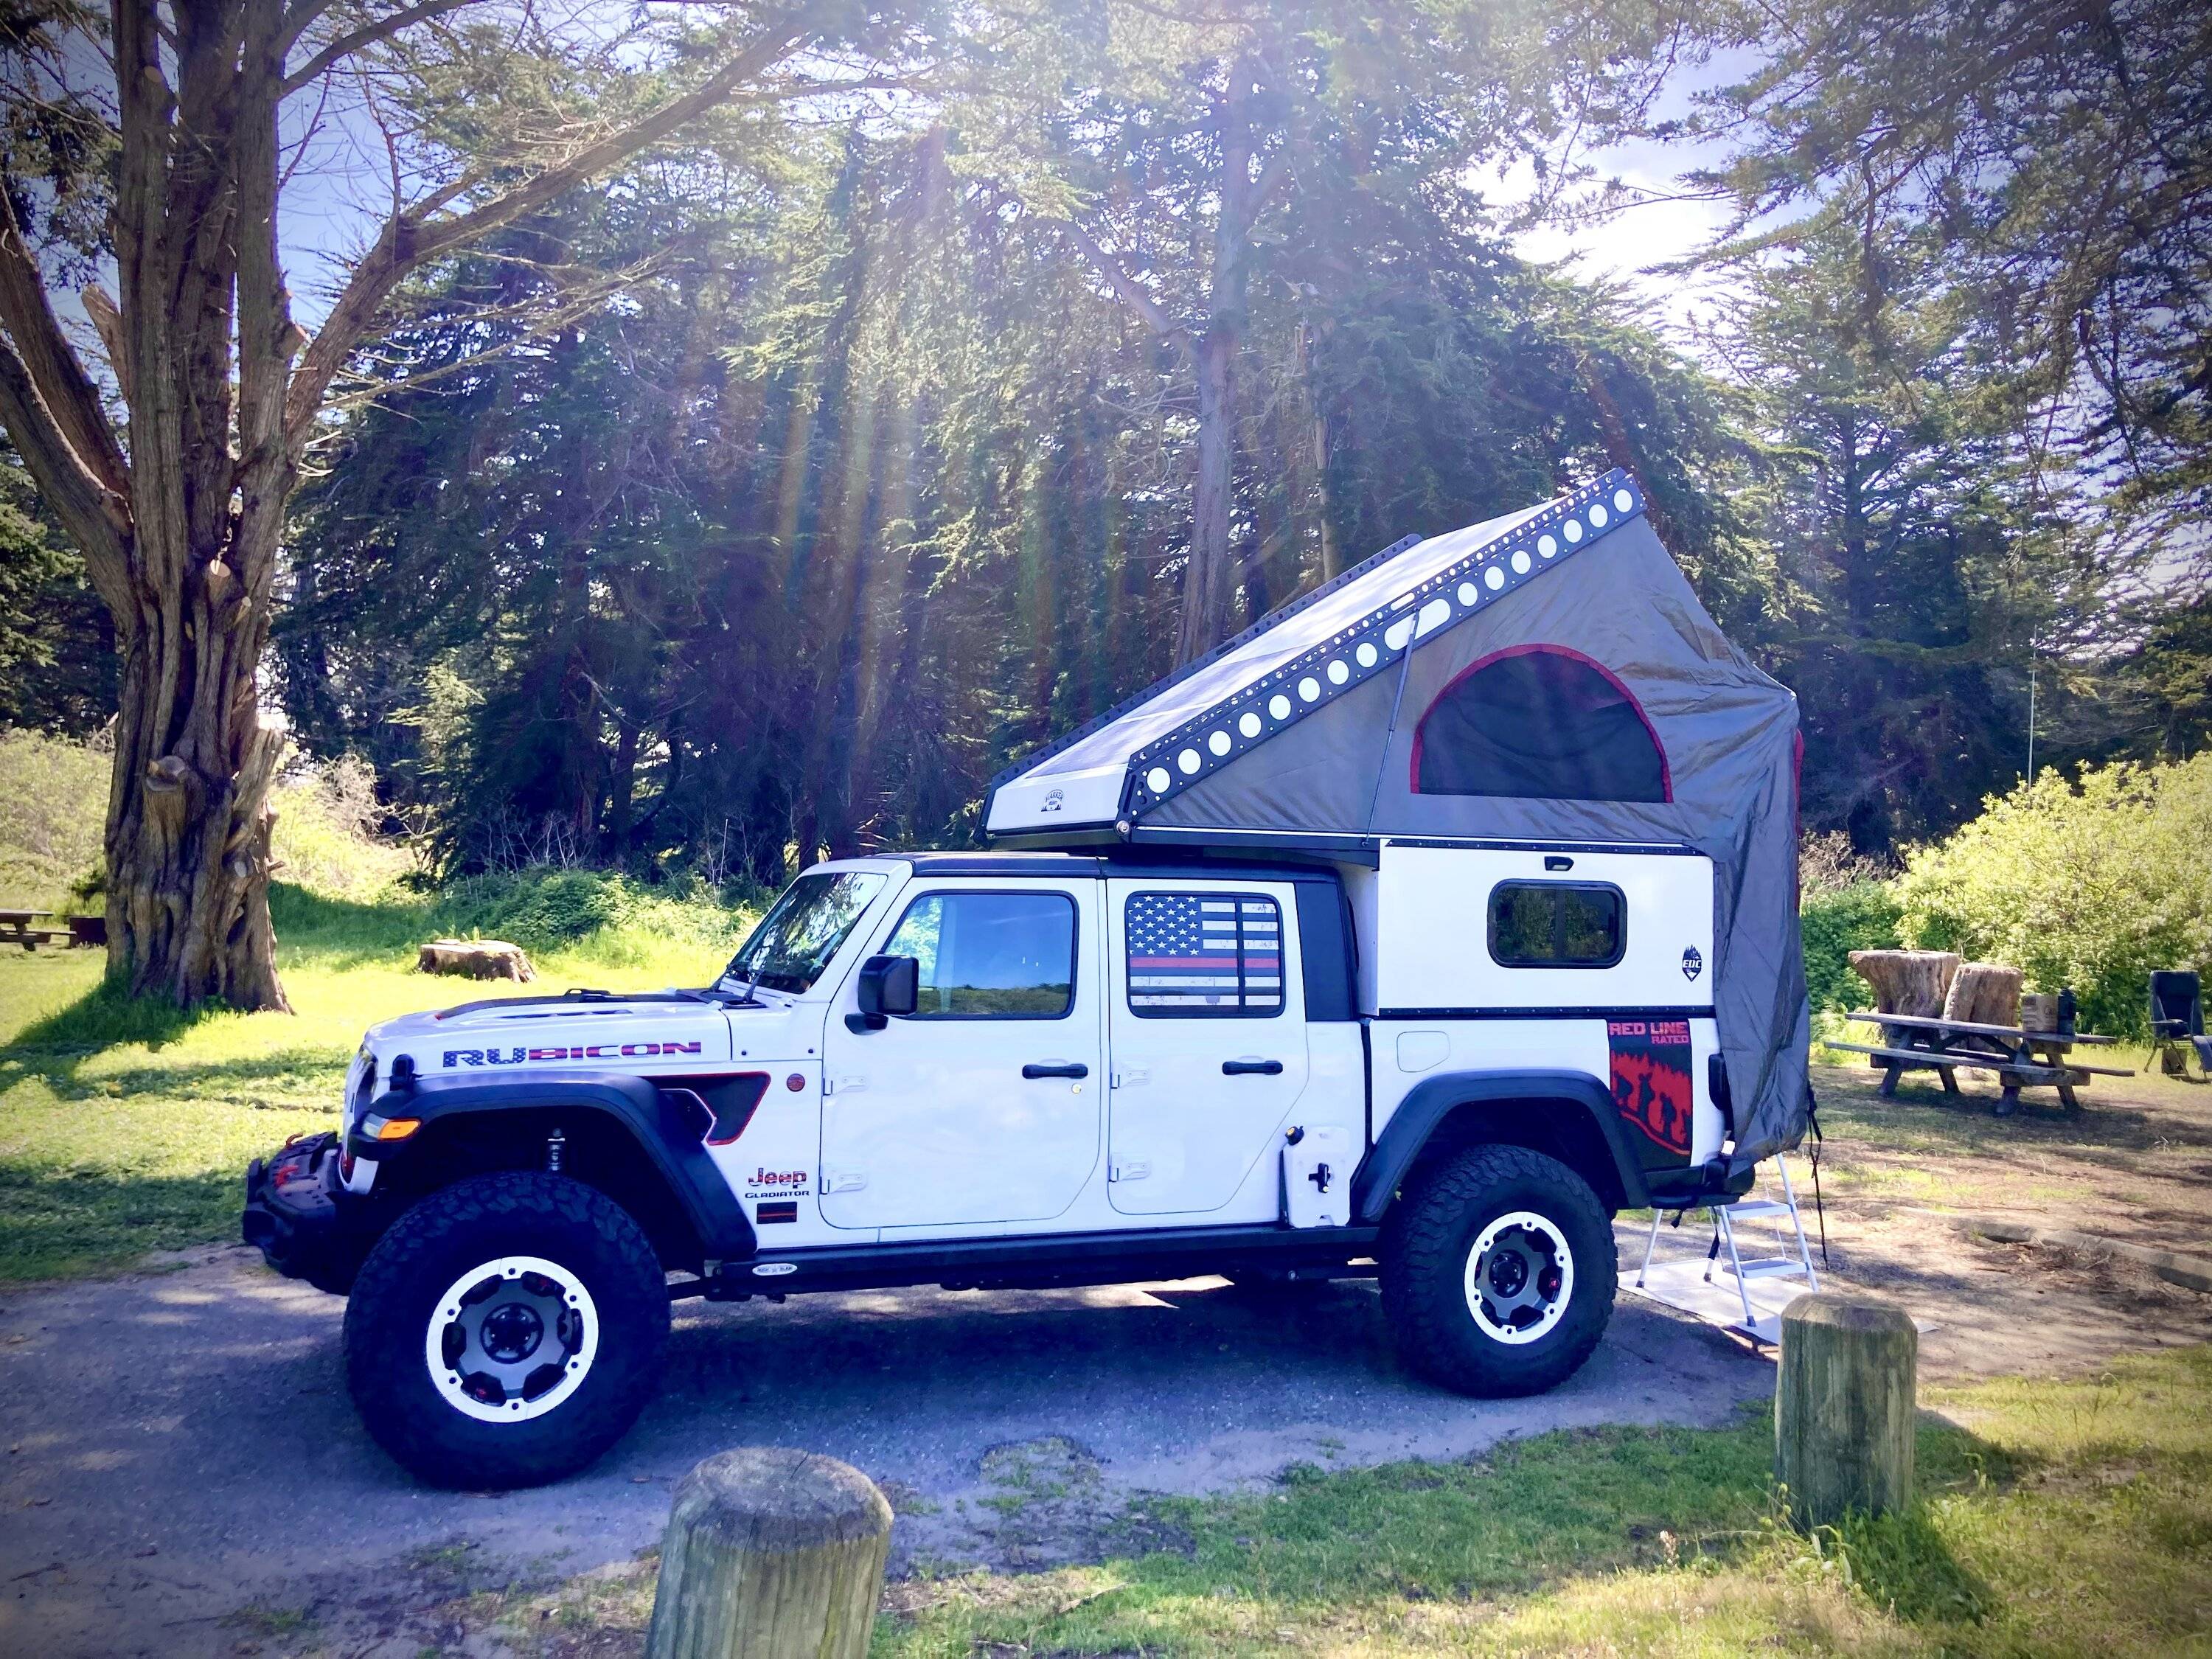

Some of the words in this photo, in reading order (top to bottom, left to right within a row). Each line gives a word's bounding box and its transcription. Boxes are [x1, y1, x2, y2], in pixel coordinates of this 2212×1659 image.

[1683, 959, 1702, 968] EDC
[1610, 1023, 1646, 1035] RED
[1651, 1022, 1688, 1034] LINE
[1652, 1035, 1689, 1044] RATED
[443, 1041, 701, 1068] RUBICON
[748, 1167, 807, 1189] Jeep
[745, 1190, 810, 1198] GLADIATOR
